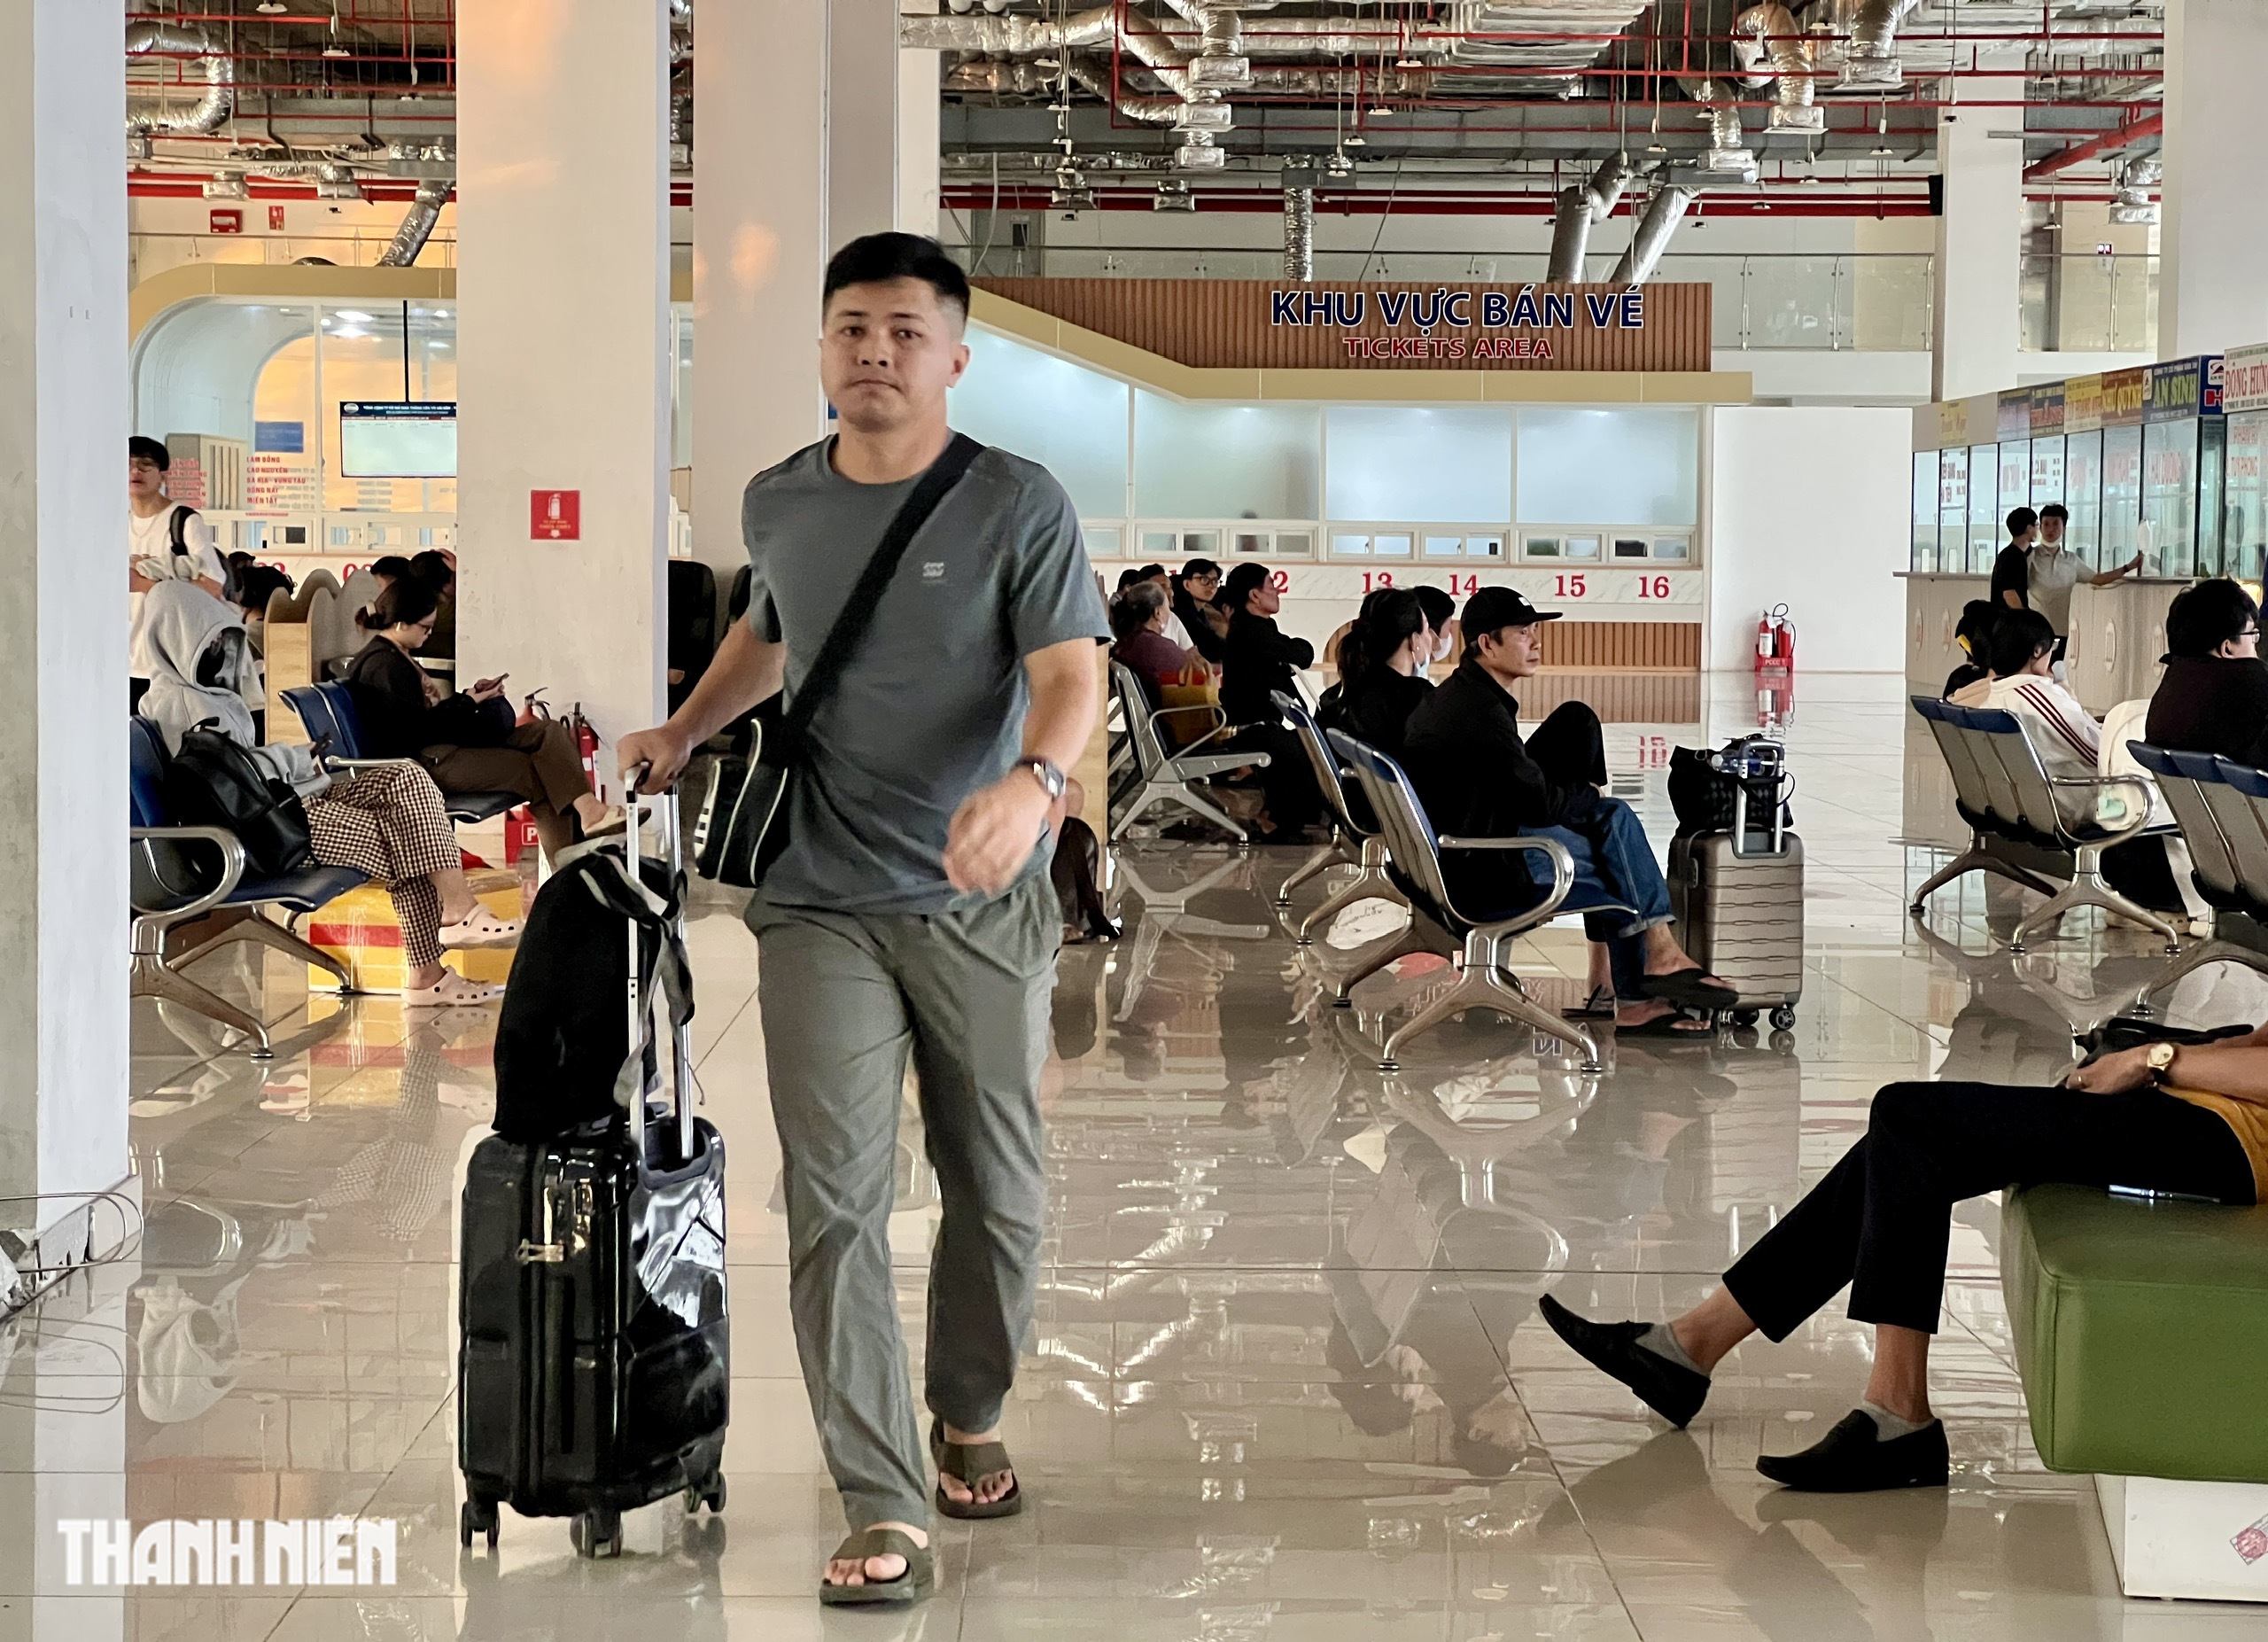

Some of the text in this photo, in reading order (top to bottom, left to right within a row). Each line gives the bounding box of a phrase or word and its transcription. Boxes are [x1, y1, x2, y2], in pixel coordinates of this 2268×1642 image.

[1270, 284, 1644, 337] KHU VỰC BÁN VÉ
[1343, 337, 1554, 359] TICKETS AREA
[2249, 359, 2268, 396] HƯN
[2153, 373, 2198, 409] AN SINH
[1273, 570, 1289, 594] 2
[1362, 572, 1393, 595] 13
[1449, 573, 1480, 596] 14
[1554, 574, 1587, 597] 15
[1637, 575, 1670, 598] 16
[526, 827, 538, 842] P
